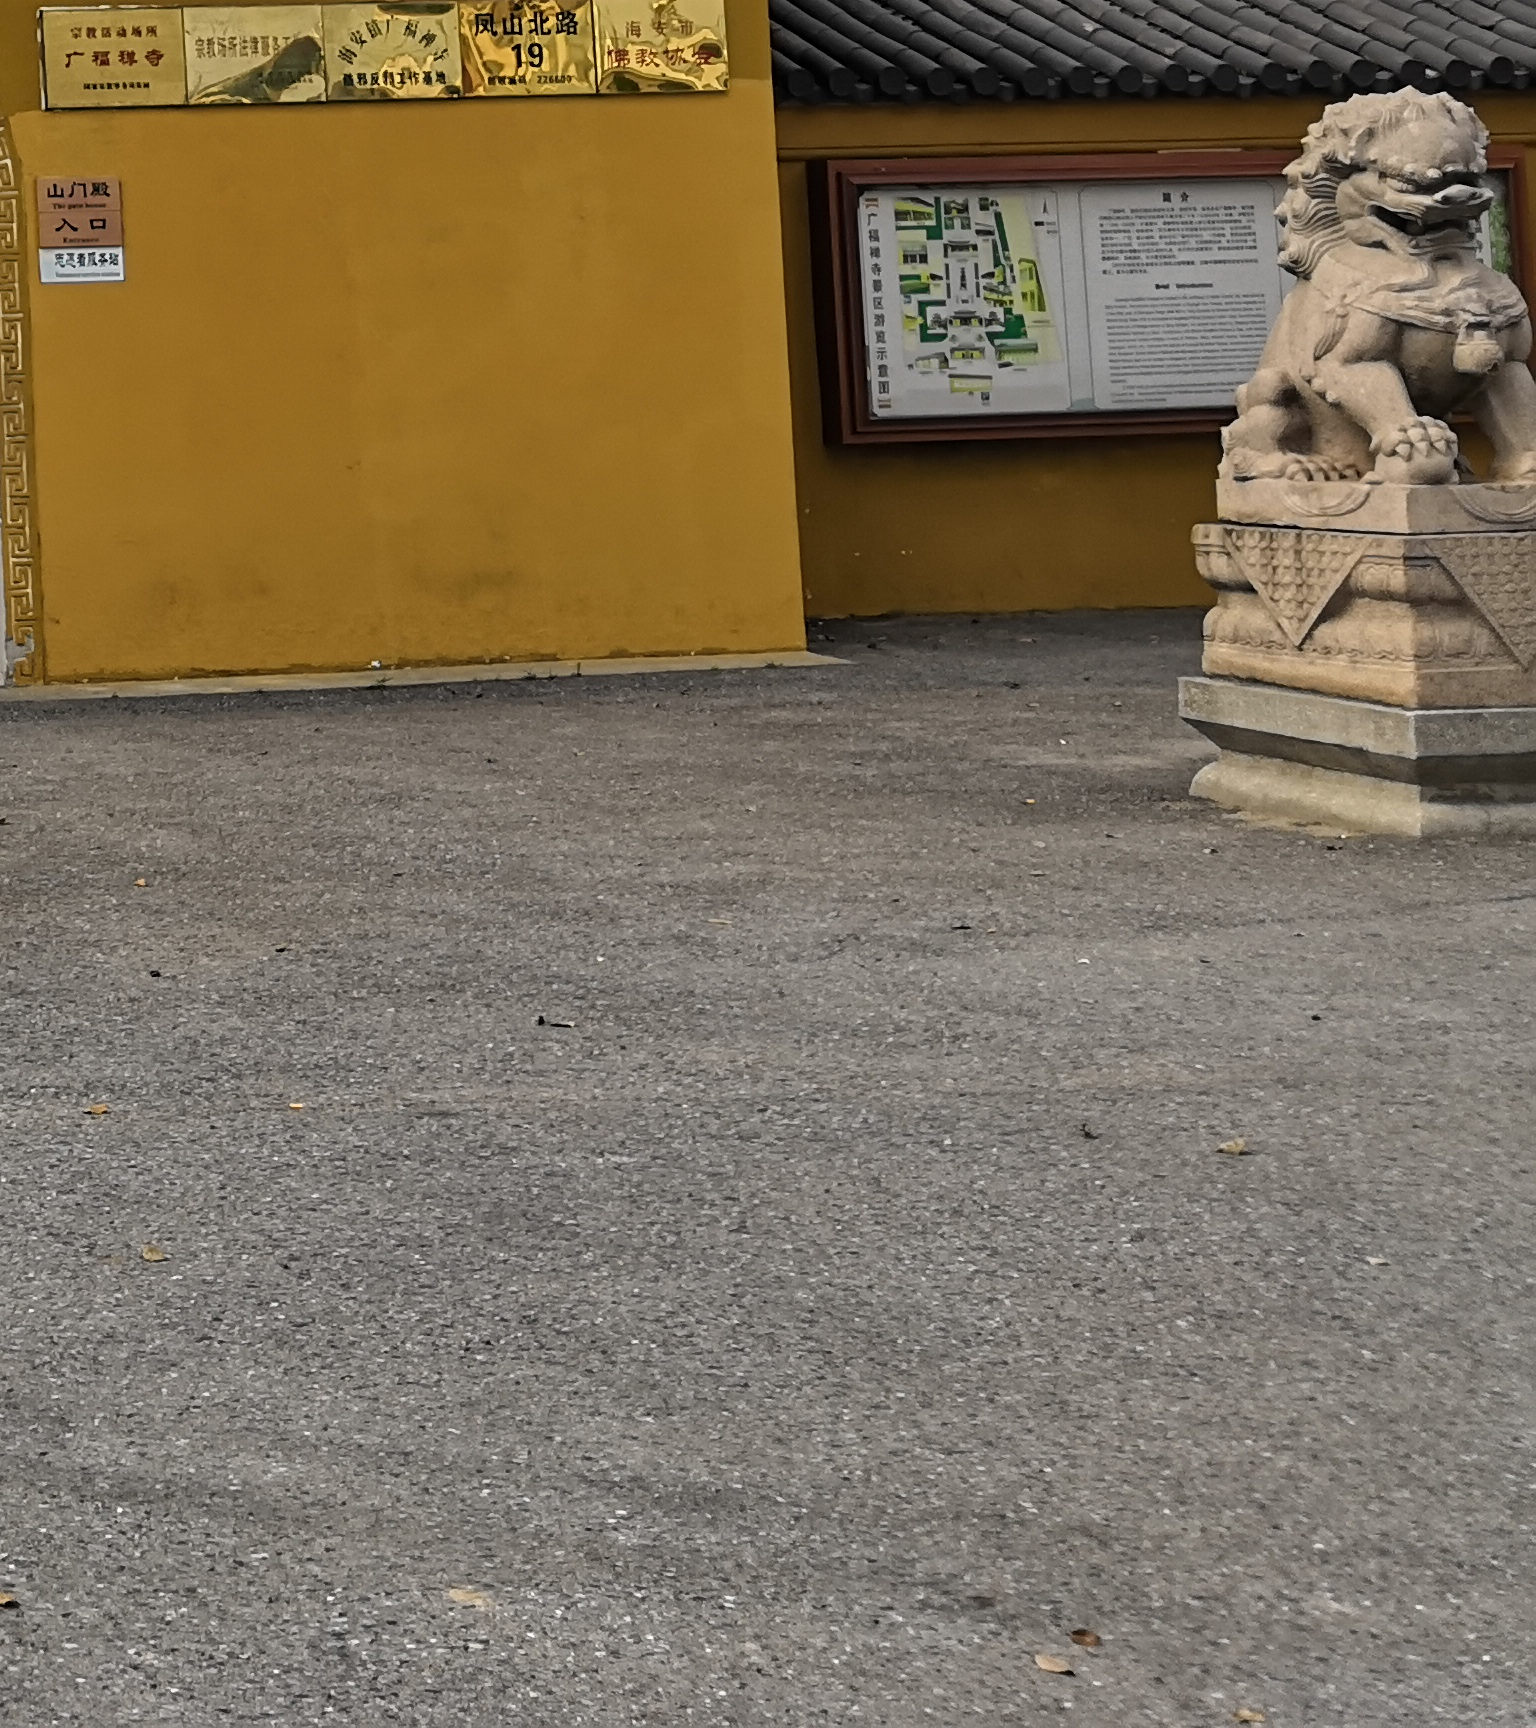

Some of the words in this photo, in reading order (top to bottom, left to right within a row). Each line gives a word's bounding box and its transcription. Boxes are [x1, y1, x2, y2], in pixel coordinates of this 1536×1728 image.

[70, 25, 158, 40] 宗教活动场所
[475, 11, 578, 37] 凤山北路
[625, 20, 694, 39] 海安市
[65, 48, 165, 69] 广福禅寺
[511, 42, 543, 69] 19
[47, 181, 111, 198] 山门殿
[55, 218, 107, 232] 入口
